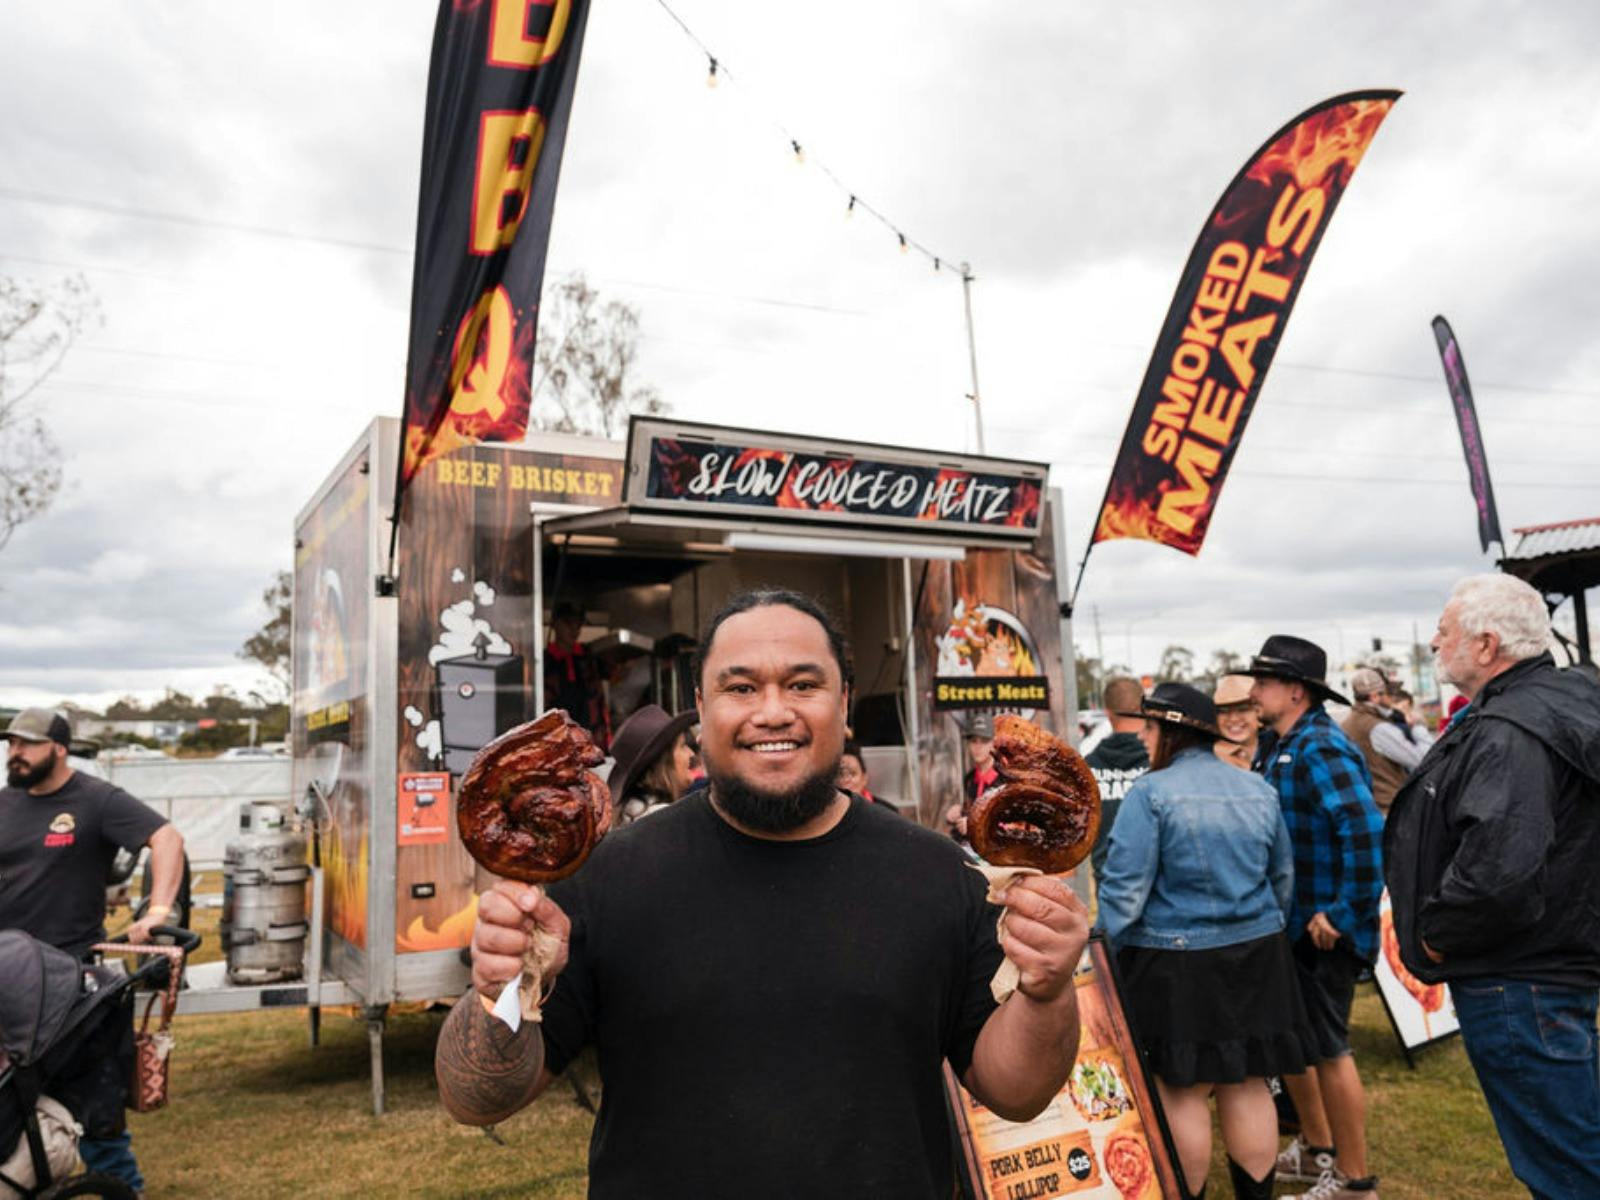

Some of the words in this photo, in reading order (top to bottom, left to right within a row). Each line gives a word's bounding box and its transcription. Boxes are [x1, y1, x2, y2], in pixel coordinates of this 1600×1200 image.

[1142, 239, 1249, 464] SMOKED
[1156, 183, 1326, 536] MEATS
[436, 459, 501, 488] BEEF
[509, 465, 613, 497] BRISKET
[688, 452, 794, 498] SLOW
[792, 461, 918, 509] COOKED
[919, 476, 1012, 523] MEATZ
[937, 684, 993, 701] Street
[990, 1153, 1024, 1178] PORK
[1024, 1142, 1062, 1169] BELLY
[1007, 1173, 1060, 1200] LOLLIPOP
